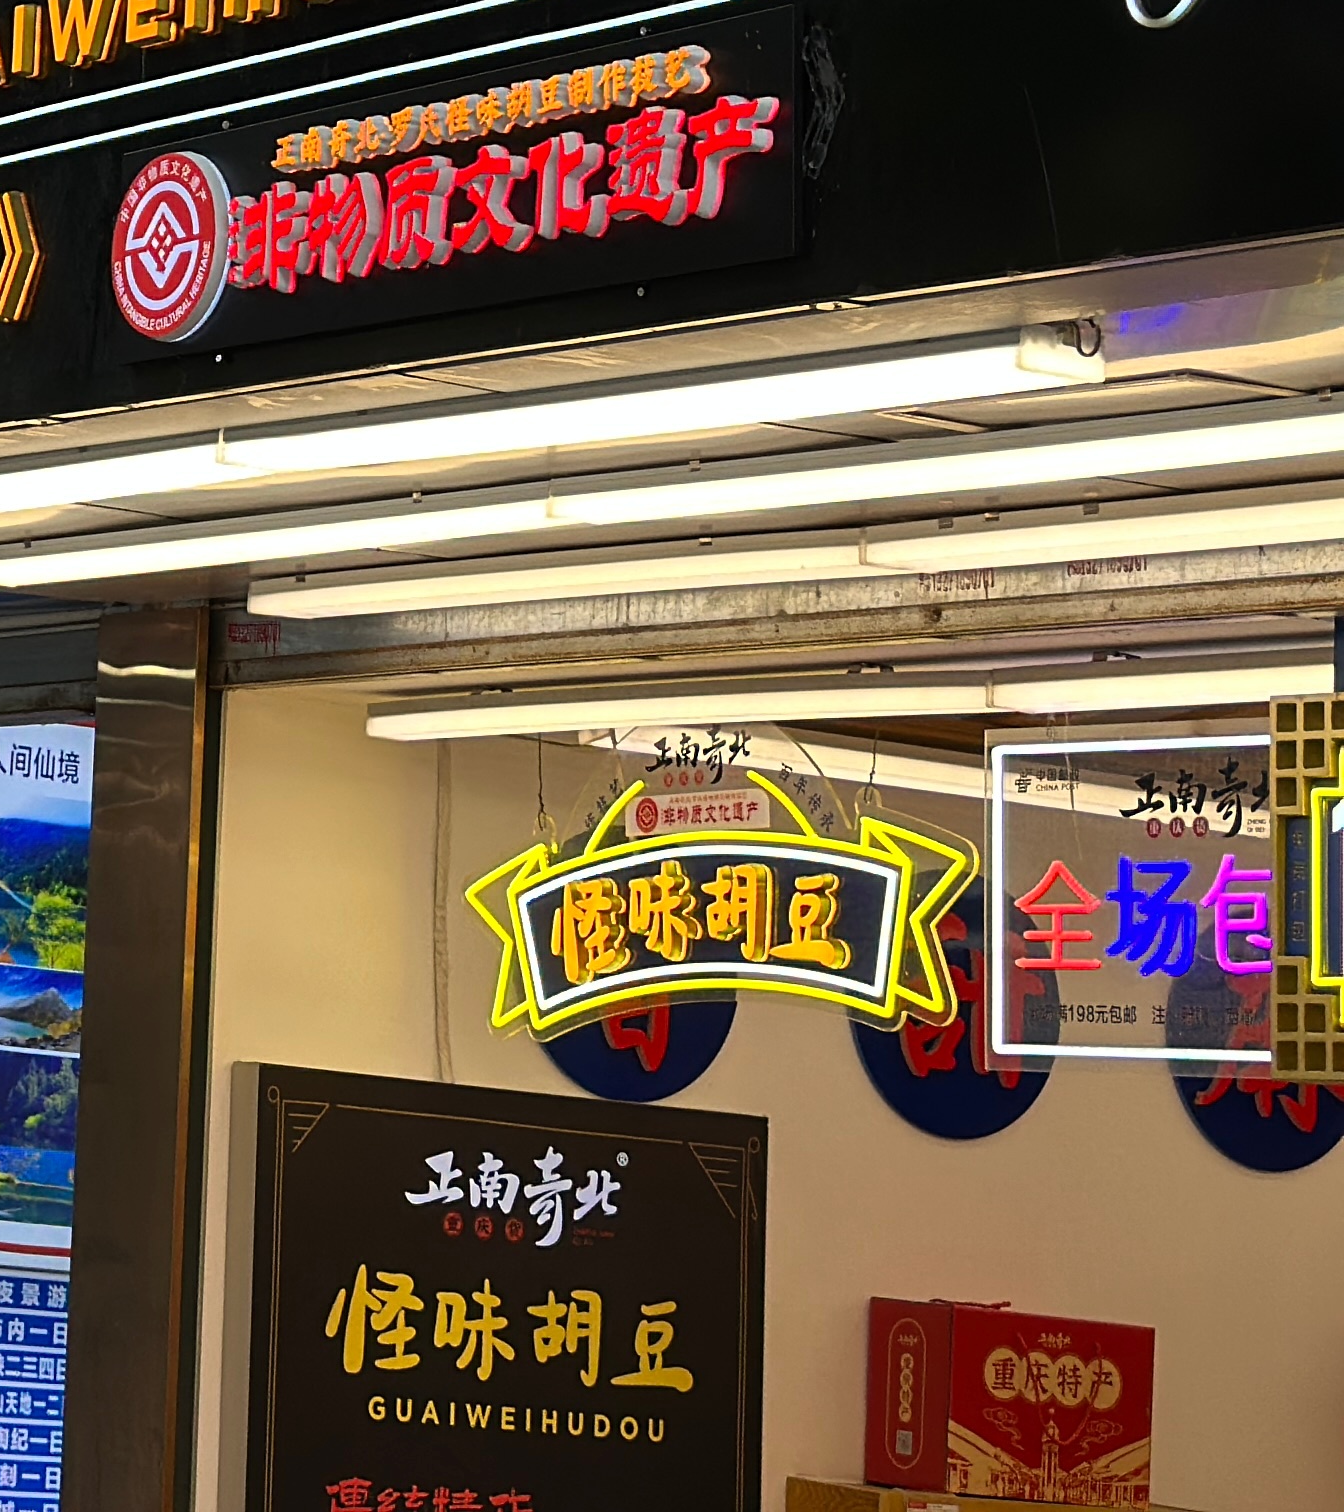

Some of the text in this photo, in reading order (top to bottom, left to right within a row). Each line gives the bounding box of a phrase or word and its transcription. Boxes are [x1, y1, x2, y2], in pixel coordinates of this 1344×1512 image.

[229, 95, 777, 293] 非物质文化遗产
[113, 239, 212, 331] CHINA INTANGIBLE CULTURAL HERITAGE
[550, 859, 850, 987] 怪味胡豆
[404, 1144, 622, 1248] 正南奇北
[324, 1261, 695, 1394] 怪味胡豆
[991, 1354, 1115, 1399] 重庆特产
[367, 1393, 667, 1445] GUAIWEIHUDOU
